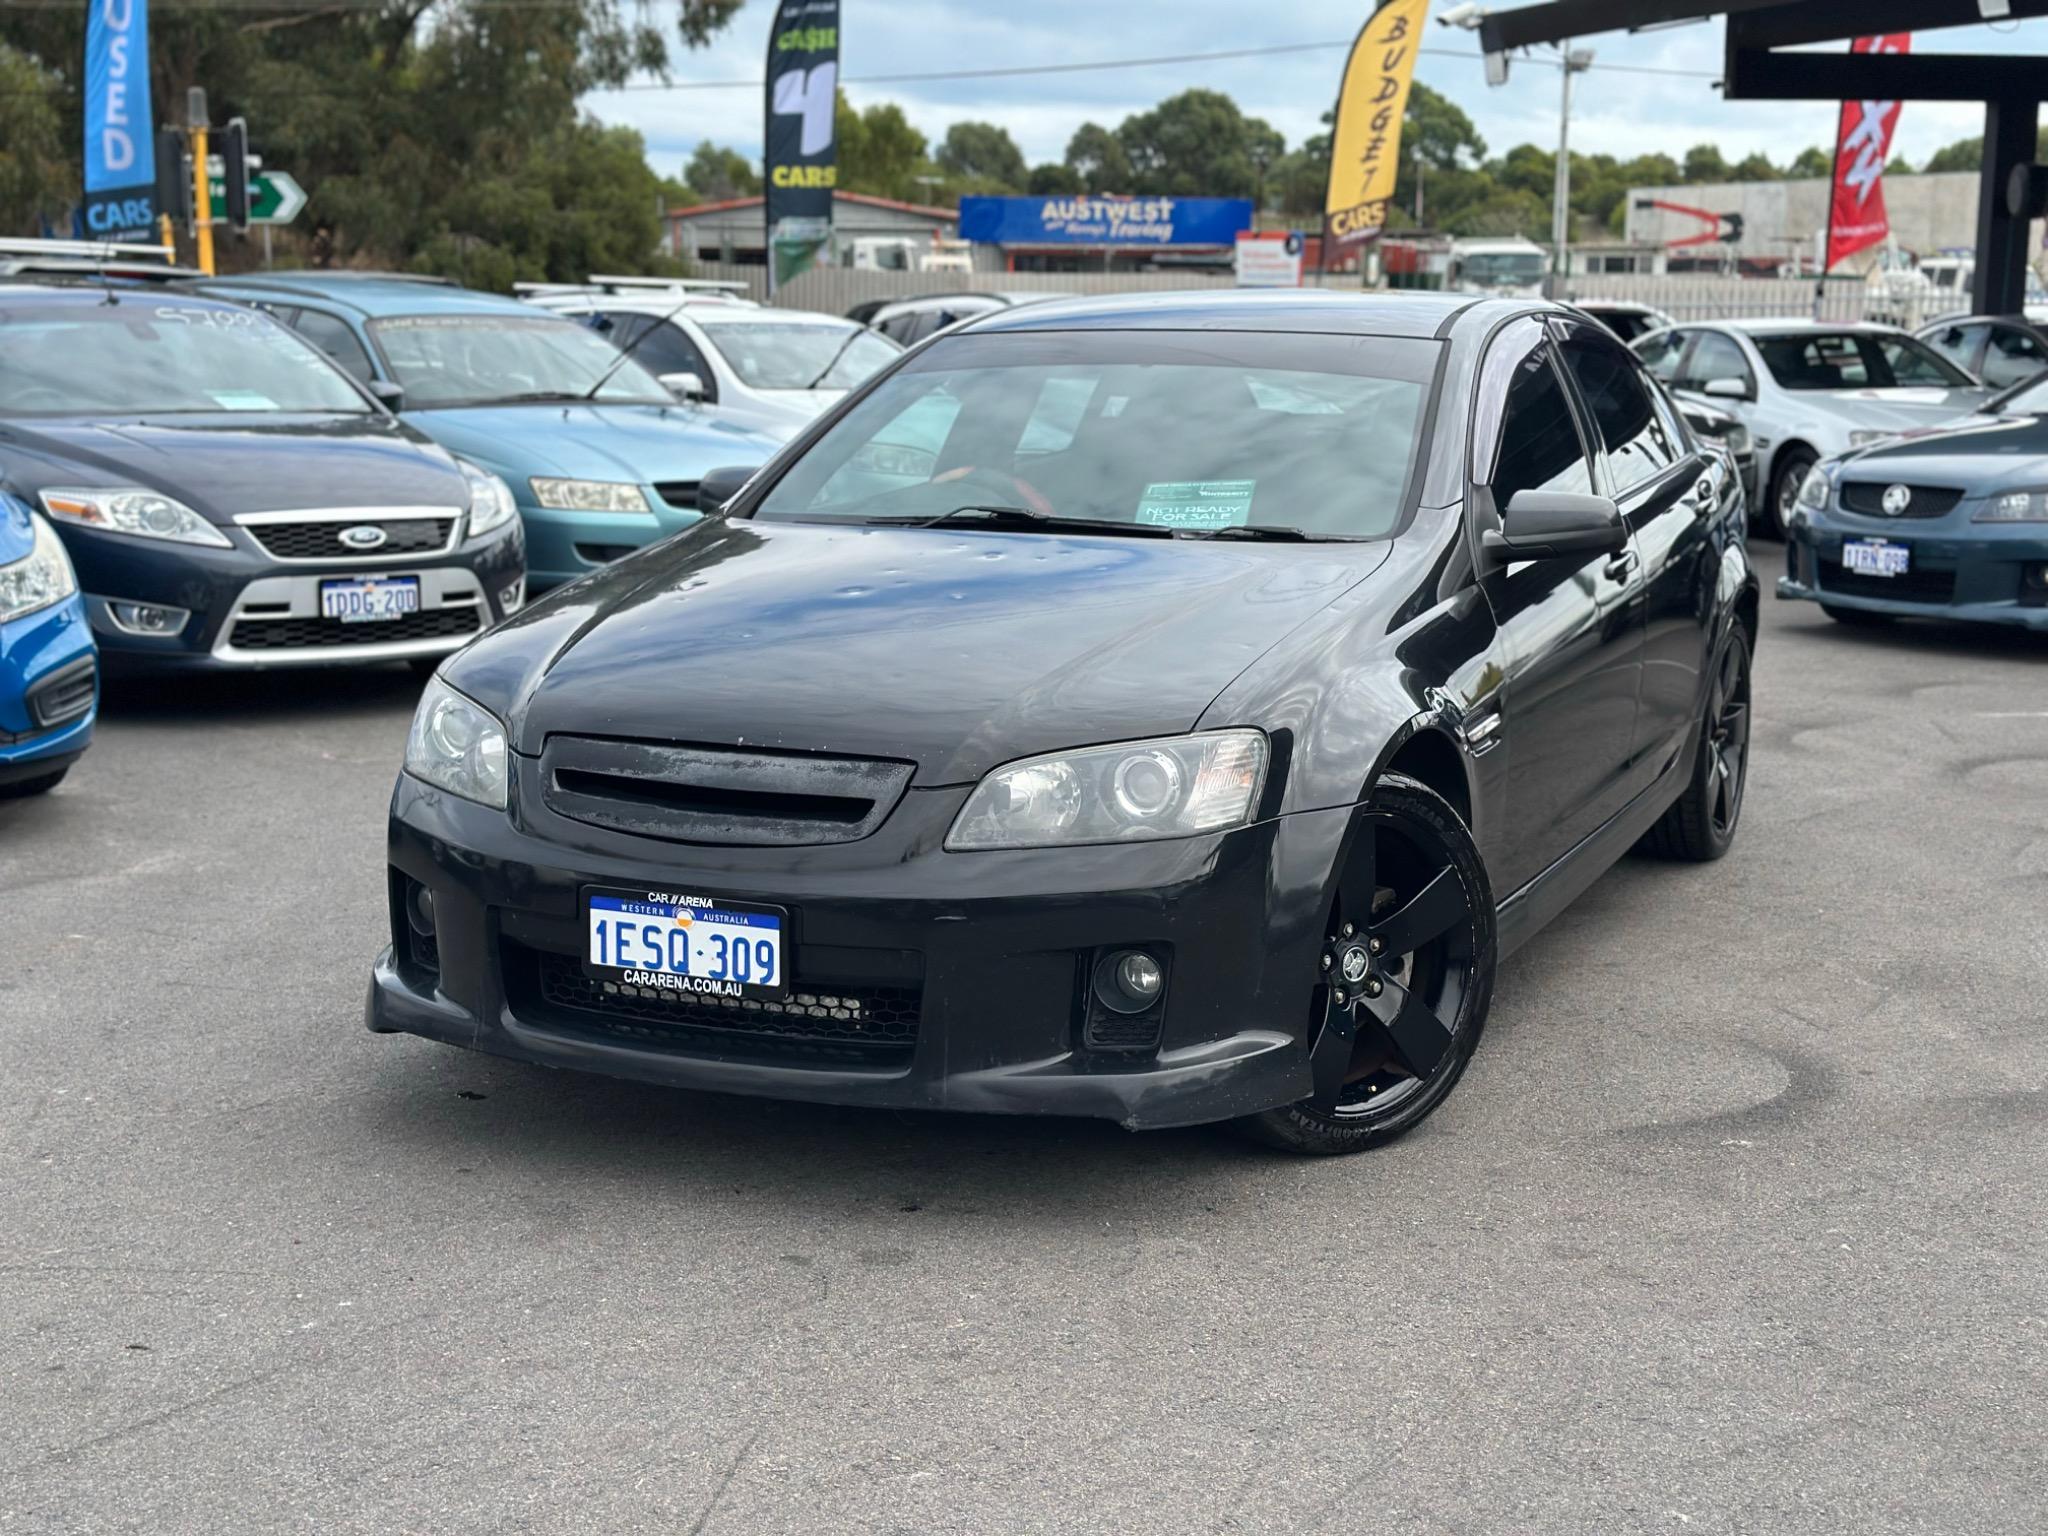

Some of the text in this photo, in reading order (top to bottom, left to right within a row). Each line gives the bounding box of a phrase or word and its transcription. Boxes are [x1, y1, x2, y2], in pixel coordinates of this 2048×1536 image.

[103, 0, 135, 171] USED
[772, 60, 837, 157] 4
[1360, 14, 1409, 195] BUDGET
[772, 165, 838, 188] CARS
[86, 199, 153, 232] CARS
[1040, 197, 1176, 222] AUSTWEST
[1330, 202, 1386, 237] CARS
[1145, 505, 1241, 515] NOT READY
[1152, 512, 1233, 521] FOR SALE
[647, 892, 669, 904] CAR
[679, 895, 714, 909] ARENA
[620, 904, 749, 925] WESTERN AUSTRALIA
[623, 969, 743, 997] CARARENA.COM.AU
